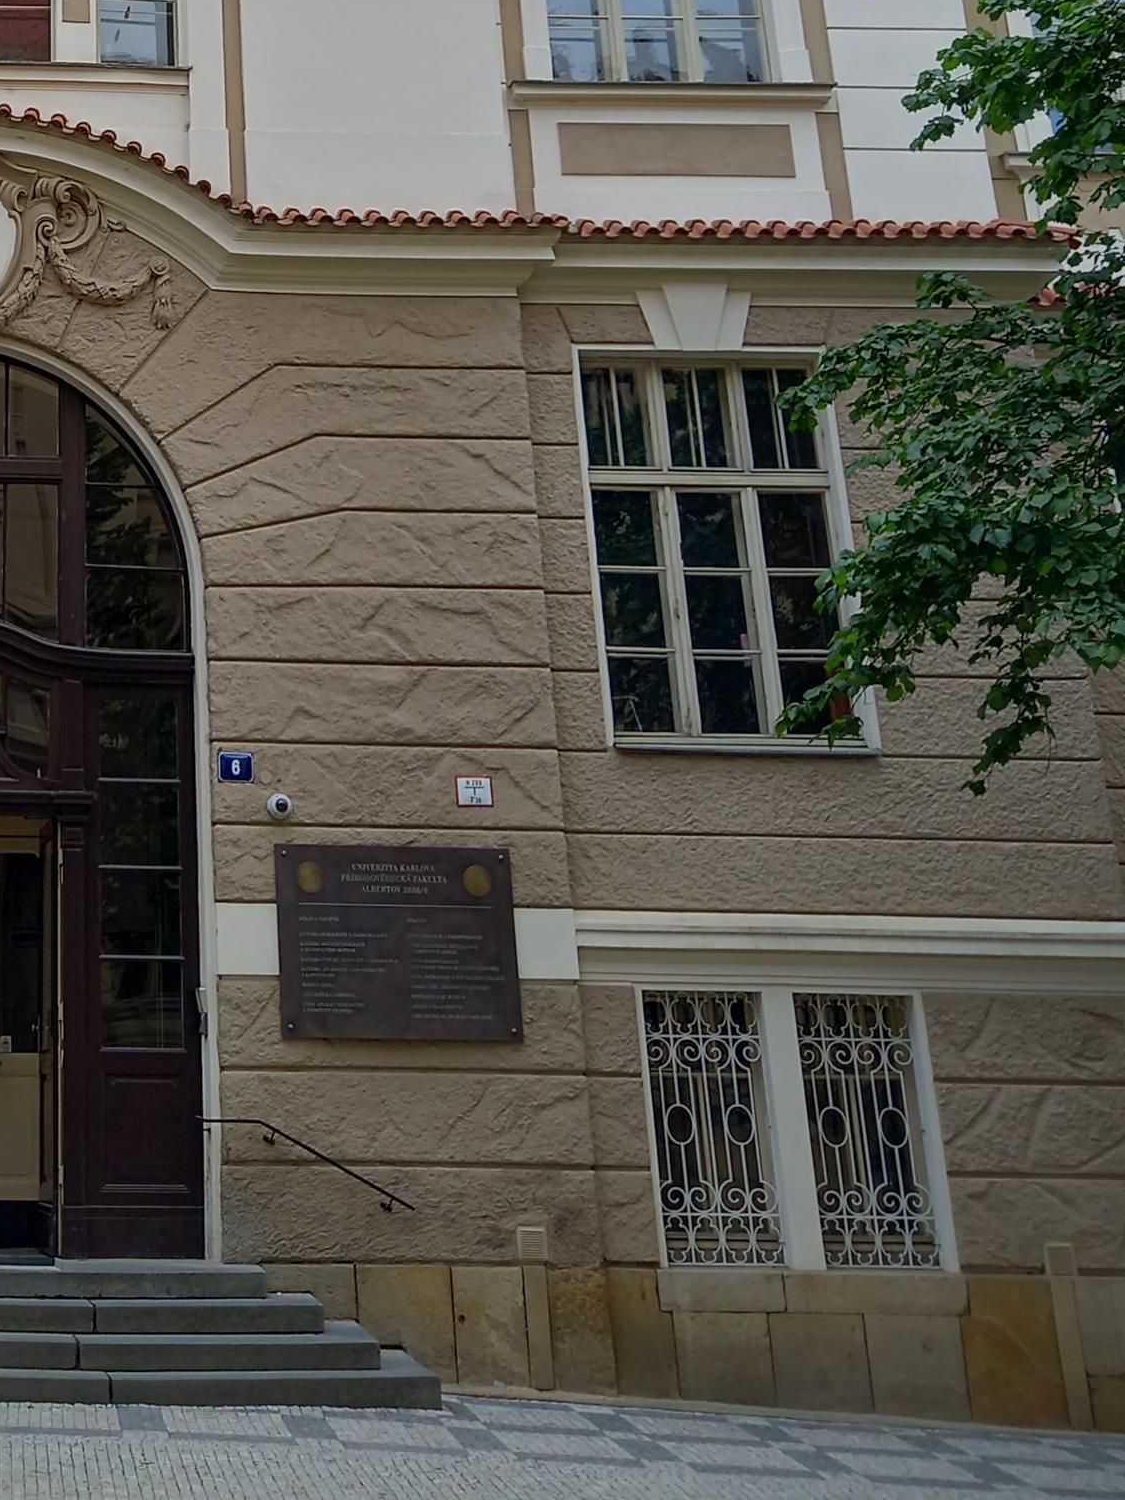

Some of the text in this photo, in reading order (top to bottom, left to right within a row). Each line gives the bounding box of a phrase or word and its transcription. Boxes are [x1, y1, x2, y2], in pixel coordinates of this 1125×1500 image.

[231, 759, 240, 775] 6
[351, 863, 435, 872] UNIVERZITA KARLOVA
[413, 874, 448, 884] FAKULTA
[362, 885, 401, 894] ALBERTOV
